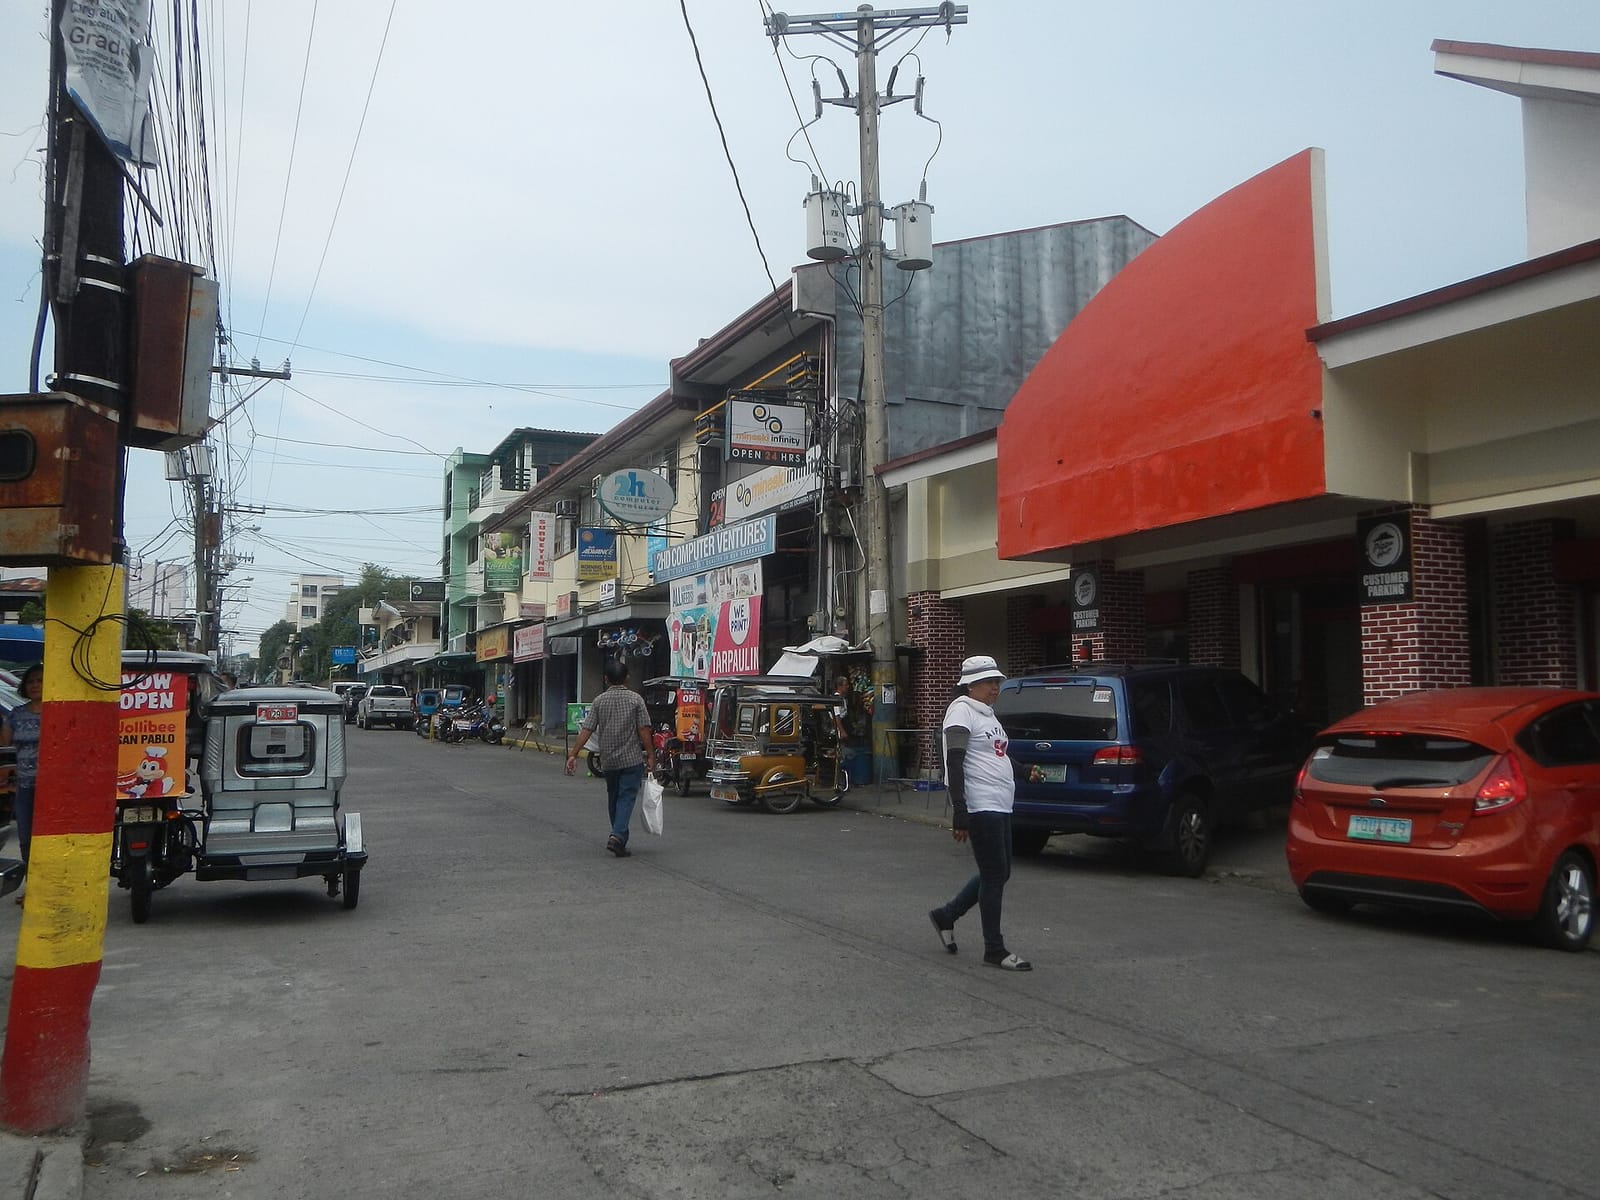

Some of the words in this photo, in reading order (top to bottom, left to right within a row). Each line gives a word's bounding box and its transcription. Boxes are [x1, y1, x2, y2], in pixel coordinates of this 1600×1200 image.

[771, 434, 800, 446] infinity
[732, 448, 761, 459] OPEN
[765, 451, 779, 461] 24
[711, 487, 726, 502] OPEN
[709, 497, 725, 527] 24
[537, 519, 546, 572] SURVEYING
[656, 550, 671, 572] 2HD
[671, 534, 715, 567] COMPUTER
[716, 519, 767, 554] VENTURES
[1363, 571, 1409, 586] CUSTOMER
[1368, 583, 1405, 597] PARKING
[733, 604, 745, 619] WE
[711, 646, 759, 674] TARPAULIN
[119, 691, 174, 710] OPEN
[118, 720, 177, 734] Jollibee
[140, 733, 175, 745] PABLO
